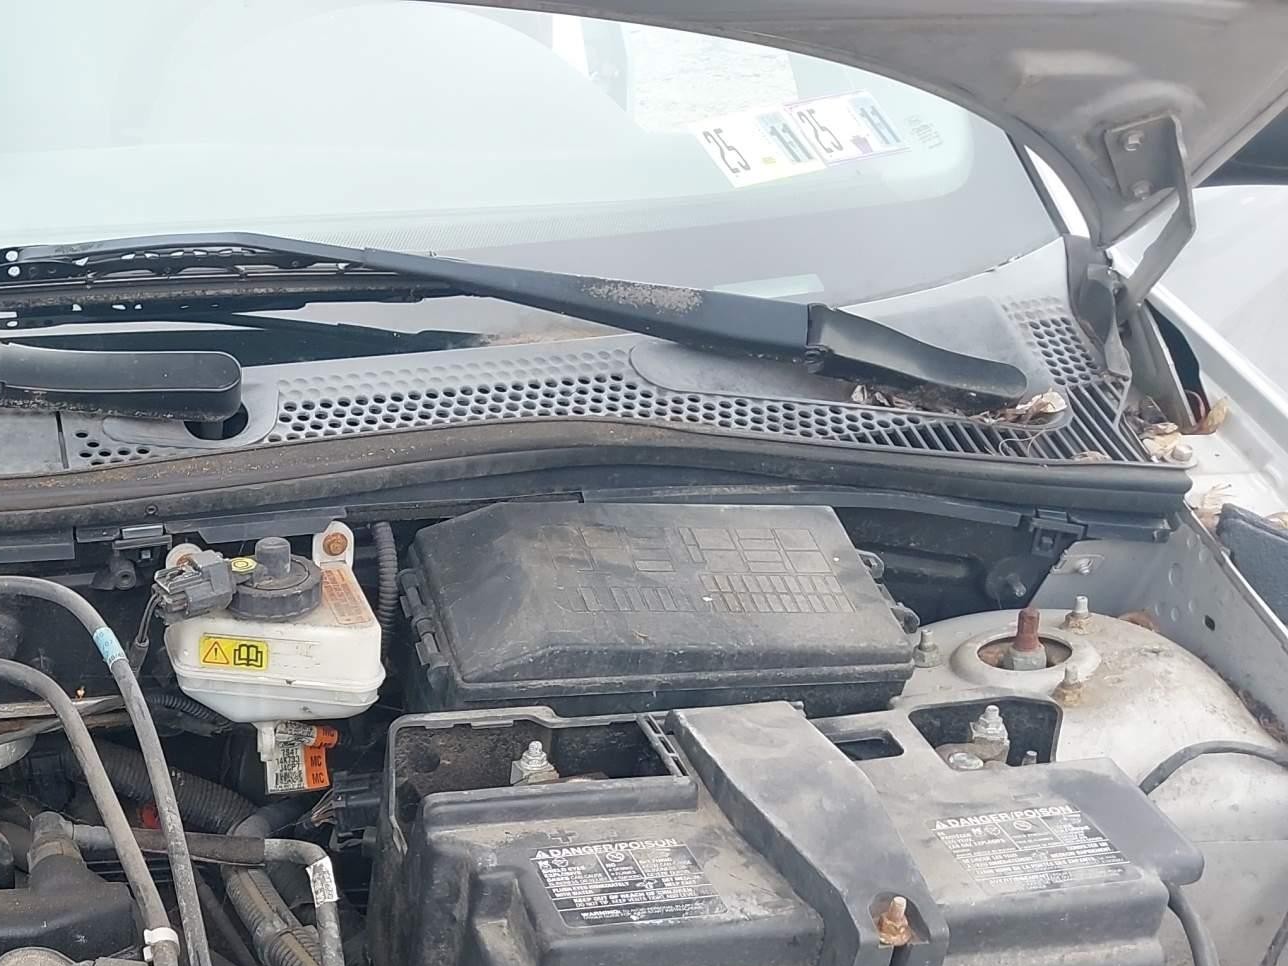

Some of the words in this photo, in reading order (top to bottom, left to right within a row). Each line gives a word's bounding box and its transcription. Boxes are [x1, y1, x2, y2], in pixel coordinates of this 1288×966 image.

[797, 108, 845, 153] 25
[859, 104, 902, 145] 11
[702, 128, 751, 173] 25
[310, 755, 322, 767] MC
[312, 772, 325, 784] MC
[947, 805, 1075, 827] DANGER/POISON
[548, 838, 678, 858] DANGER/POISON
